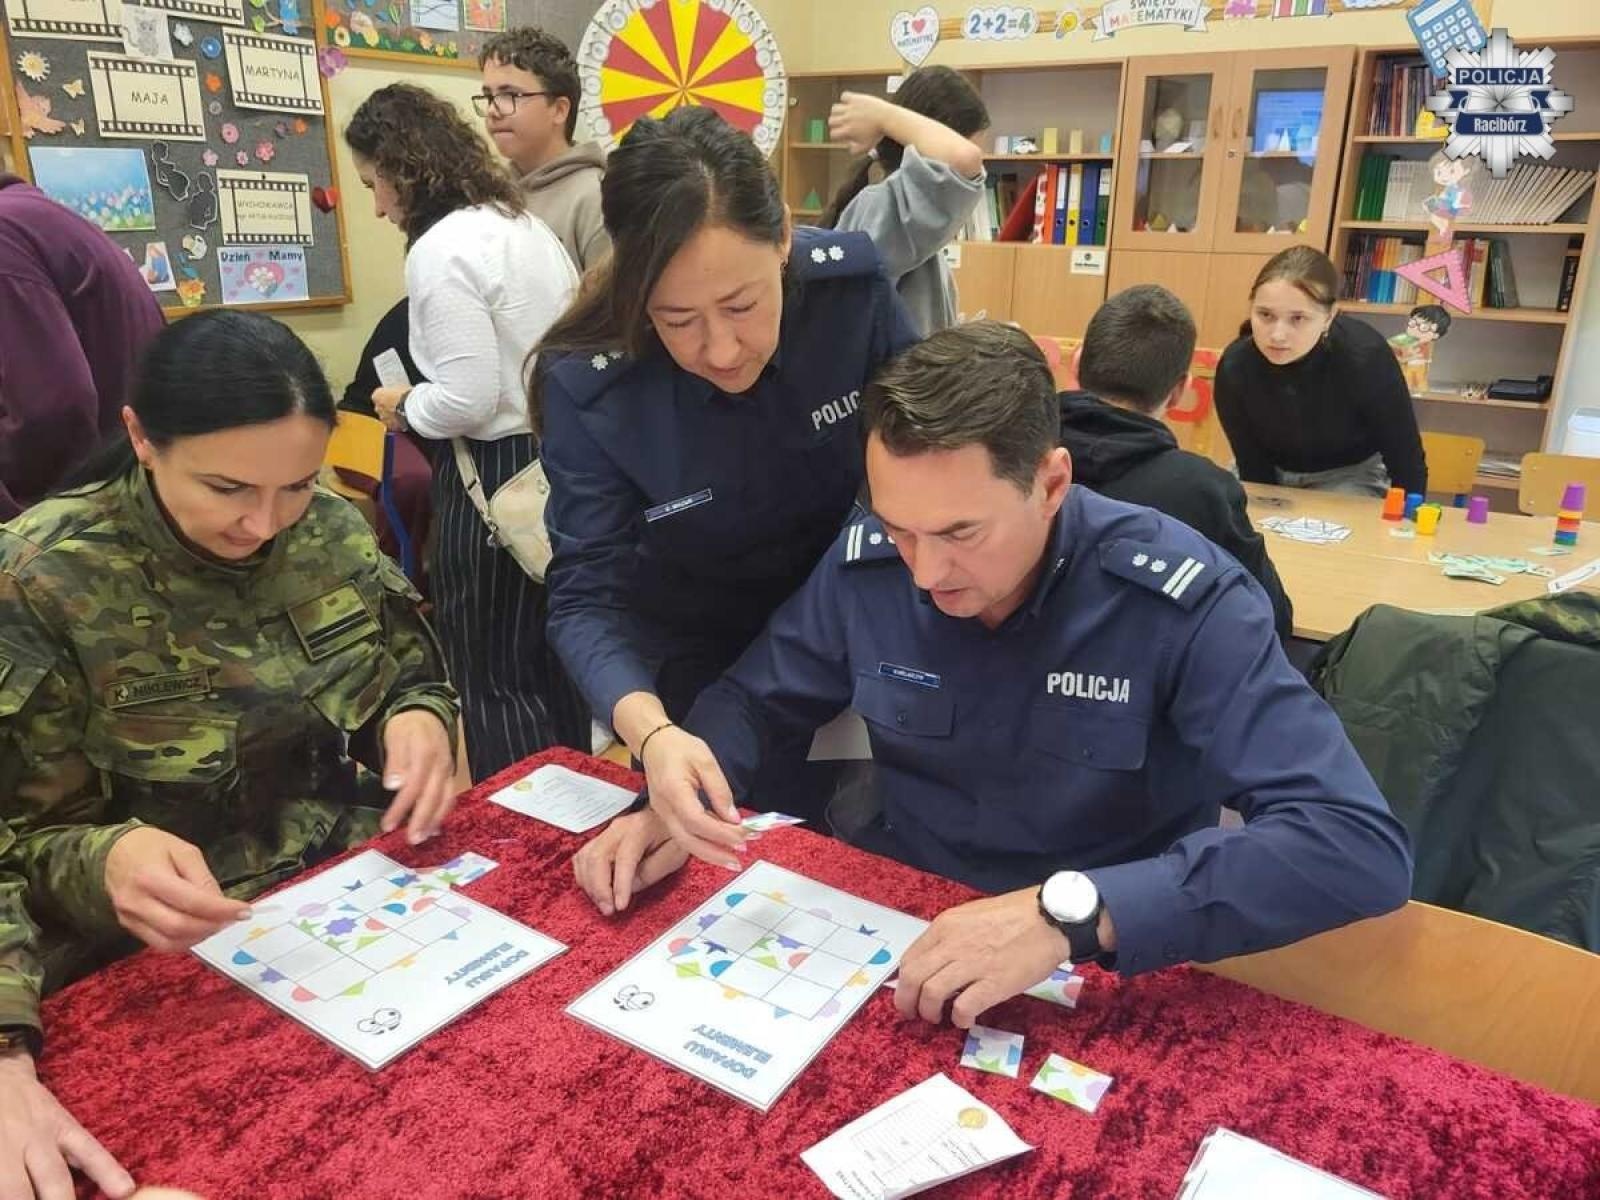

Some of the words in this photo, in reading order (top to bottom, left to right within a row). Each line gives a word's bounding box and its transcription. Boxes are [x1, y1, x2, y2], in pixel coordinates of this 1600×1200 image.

[969, 11, 1032, 34] 2+2=4
[245, 65, 300, 81] MARTYNA
[131, 91, 169, 105] MAJA
[269, 251, 303, 261] Mamy
[1047, 671, 1131, 704] POLICJA
